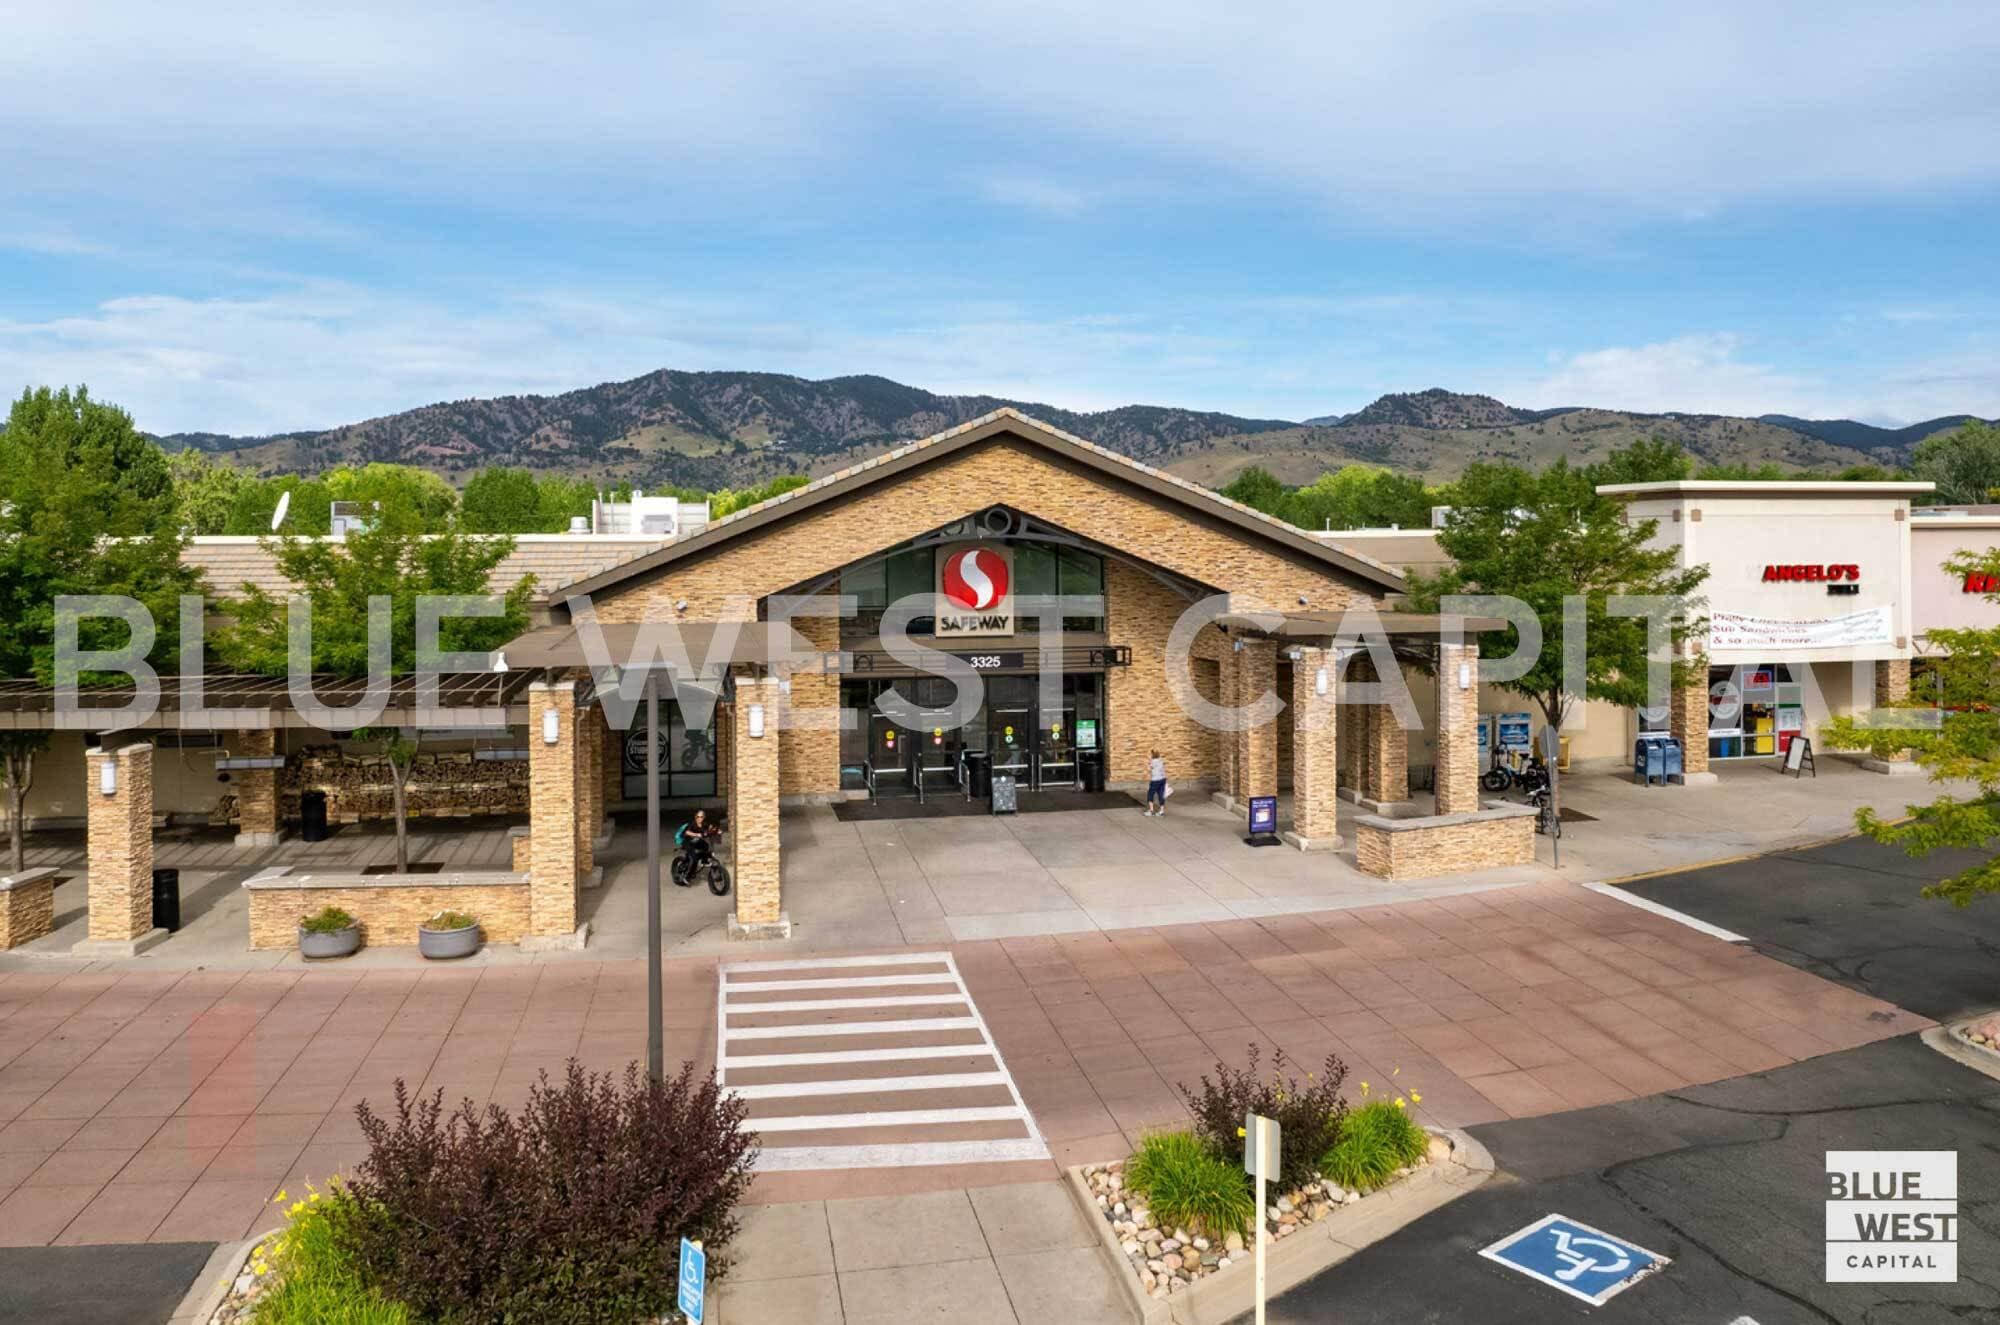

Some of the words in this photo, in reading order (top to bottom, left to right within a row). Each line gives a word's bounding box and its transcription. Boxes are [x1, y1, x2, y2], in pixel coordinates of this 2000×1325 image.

[1761, 564, 1860, 583] ANGELO'S
[941, 615, 1009, 631] SAFEWAY
[970, 655, 1001, 668] 3325
